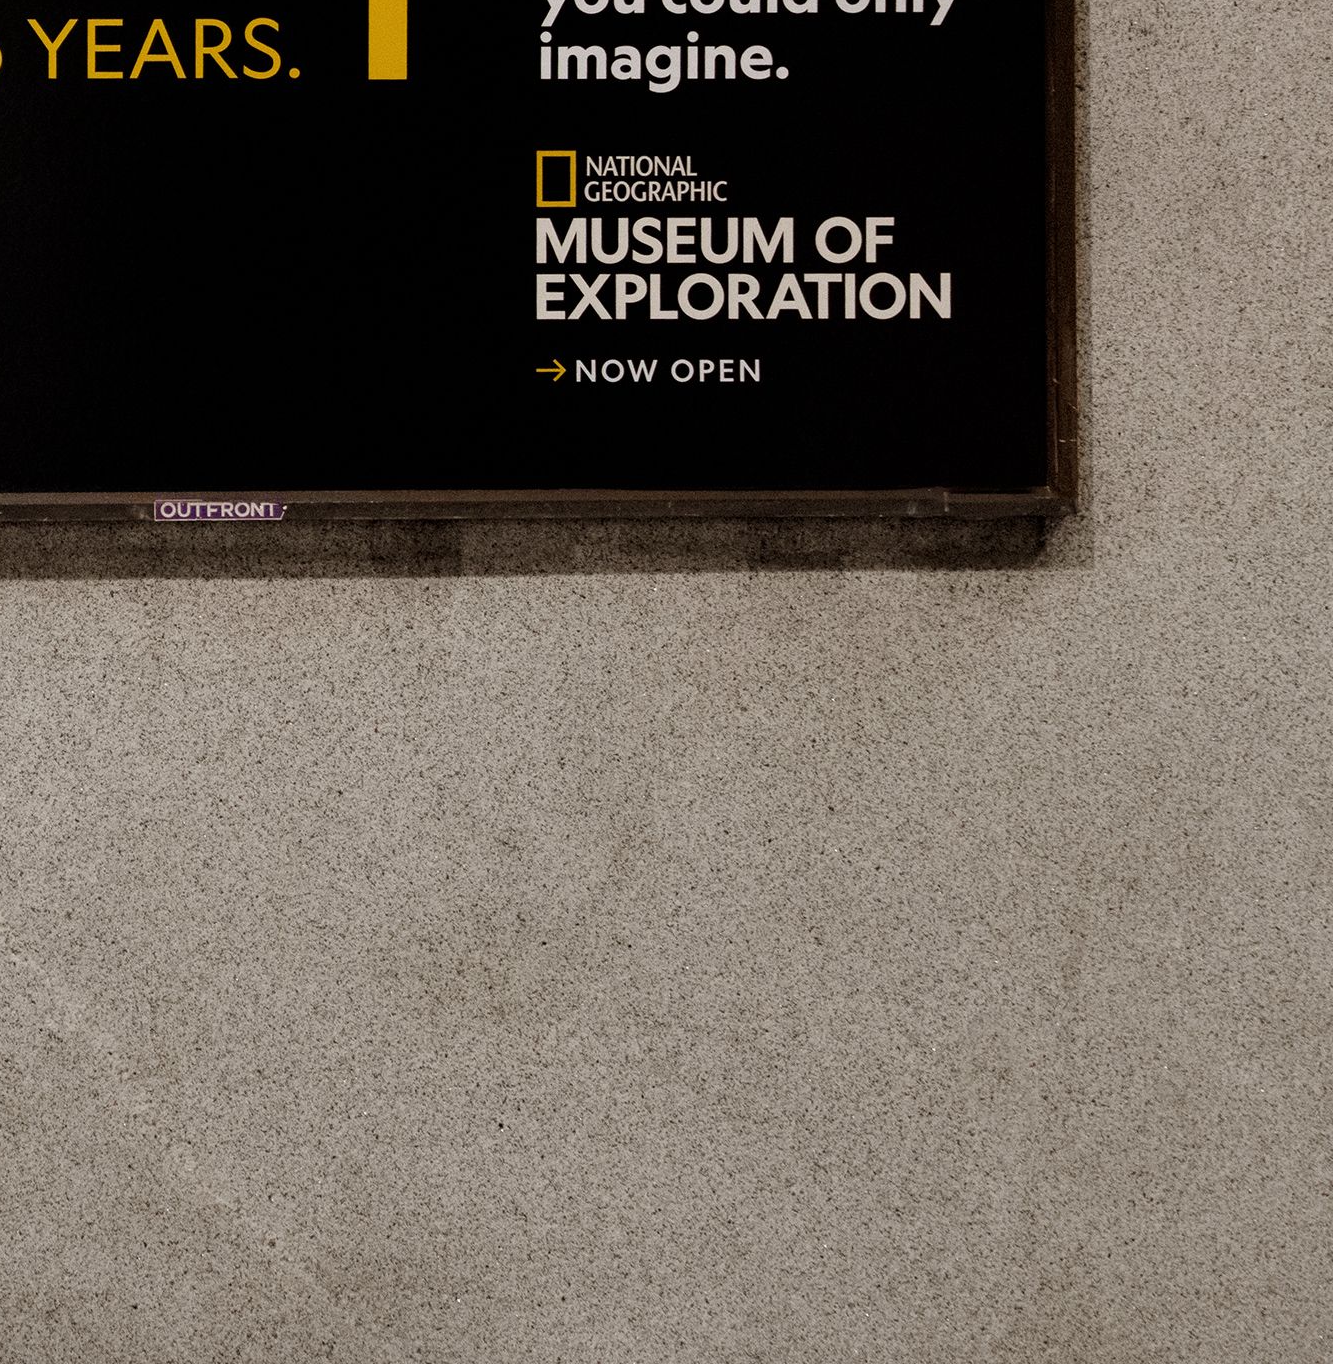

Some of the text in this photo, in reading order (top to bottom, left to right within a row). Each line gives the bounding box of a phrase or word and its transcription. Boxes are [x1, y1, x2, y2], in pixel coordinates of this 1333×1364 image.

[27, 17, 302, 81] YEARS.
[539, 30, 790, 94] imagine.
[585, 155, 698, 177] NATIONAL
[583, 180, 728, 203] GEOGRAPHIC
[535, 216, 895, 265] MUSEUM OF
[535, 272, 952, 321] EXPLORATION
[575, 358, 761, 383] NOW OPEN
[160, 502, 276, 518] OUTFRONT
